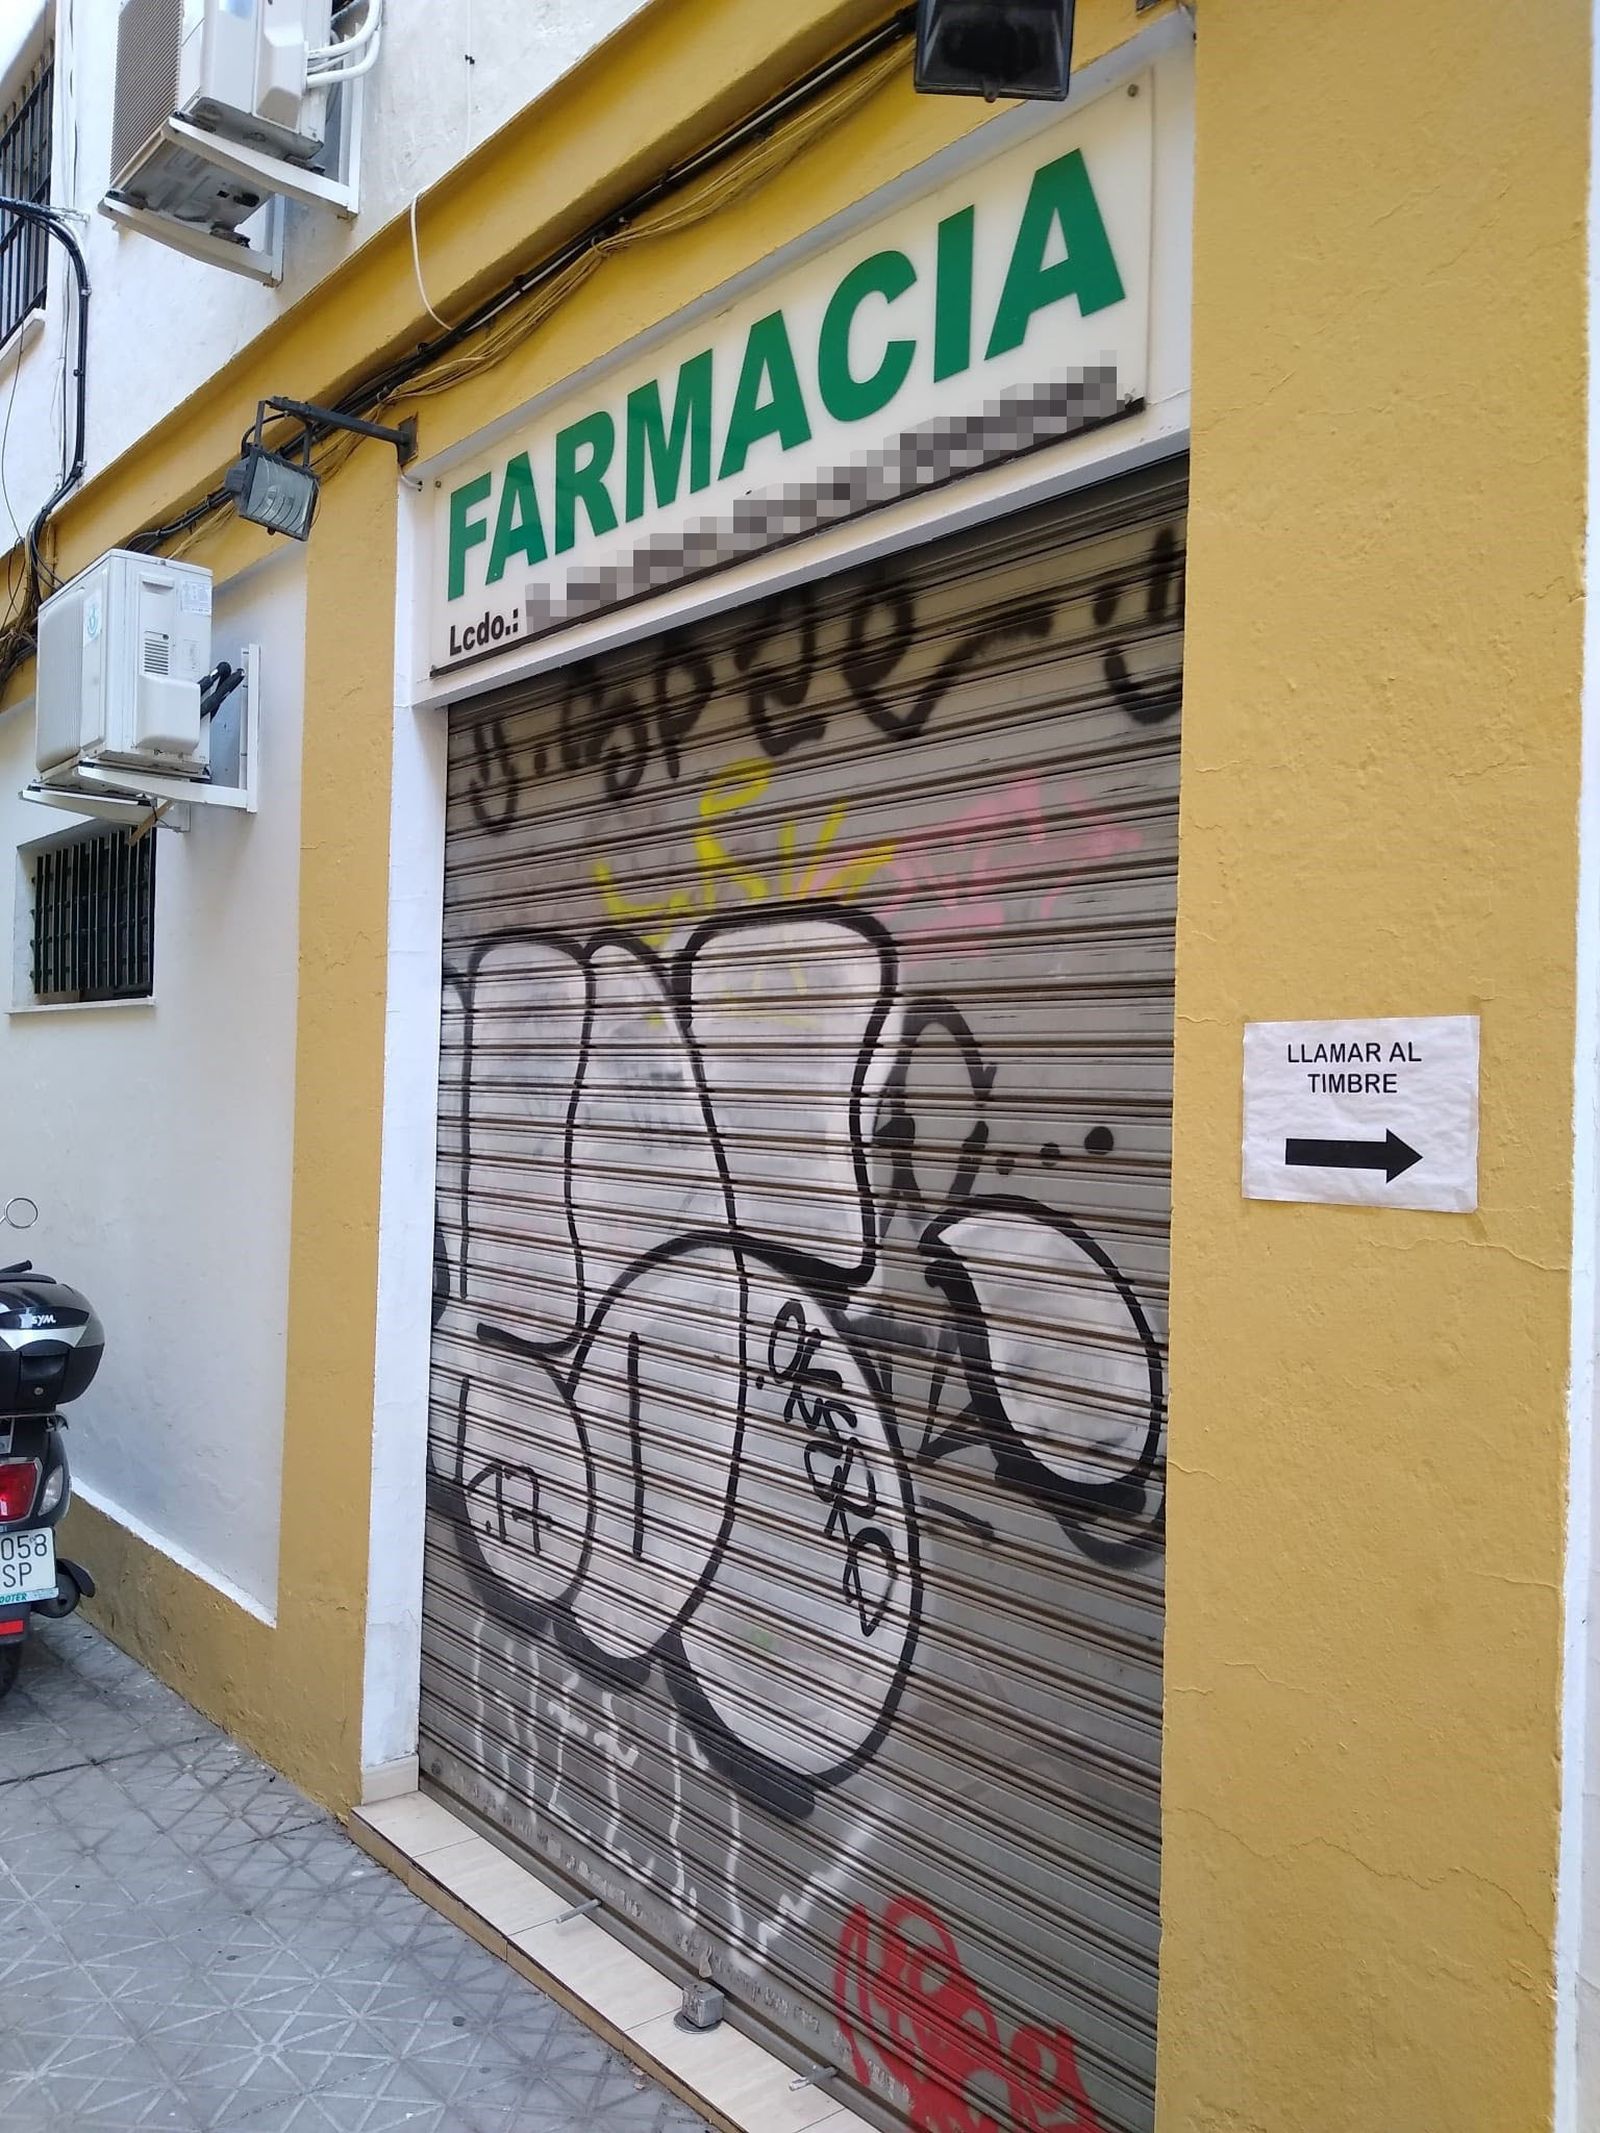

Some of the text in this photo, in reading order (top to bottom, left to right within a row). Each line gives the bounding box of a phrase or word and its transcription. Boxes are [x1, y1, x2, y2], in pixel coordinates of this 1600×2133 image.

[447, 148, 1126, 602] FARMACIA
[449, 608, 519, 657] Lcdo.:
[1287, 1041, 1423, 1064] LLAMAR AL
[1307, 1073, 1399, 1094] TIMBRE
[2, 1562, 33, 1588] SP
